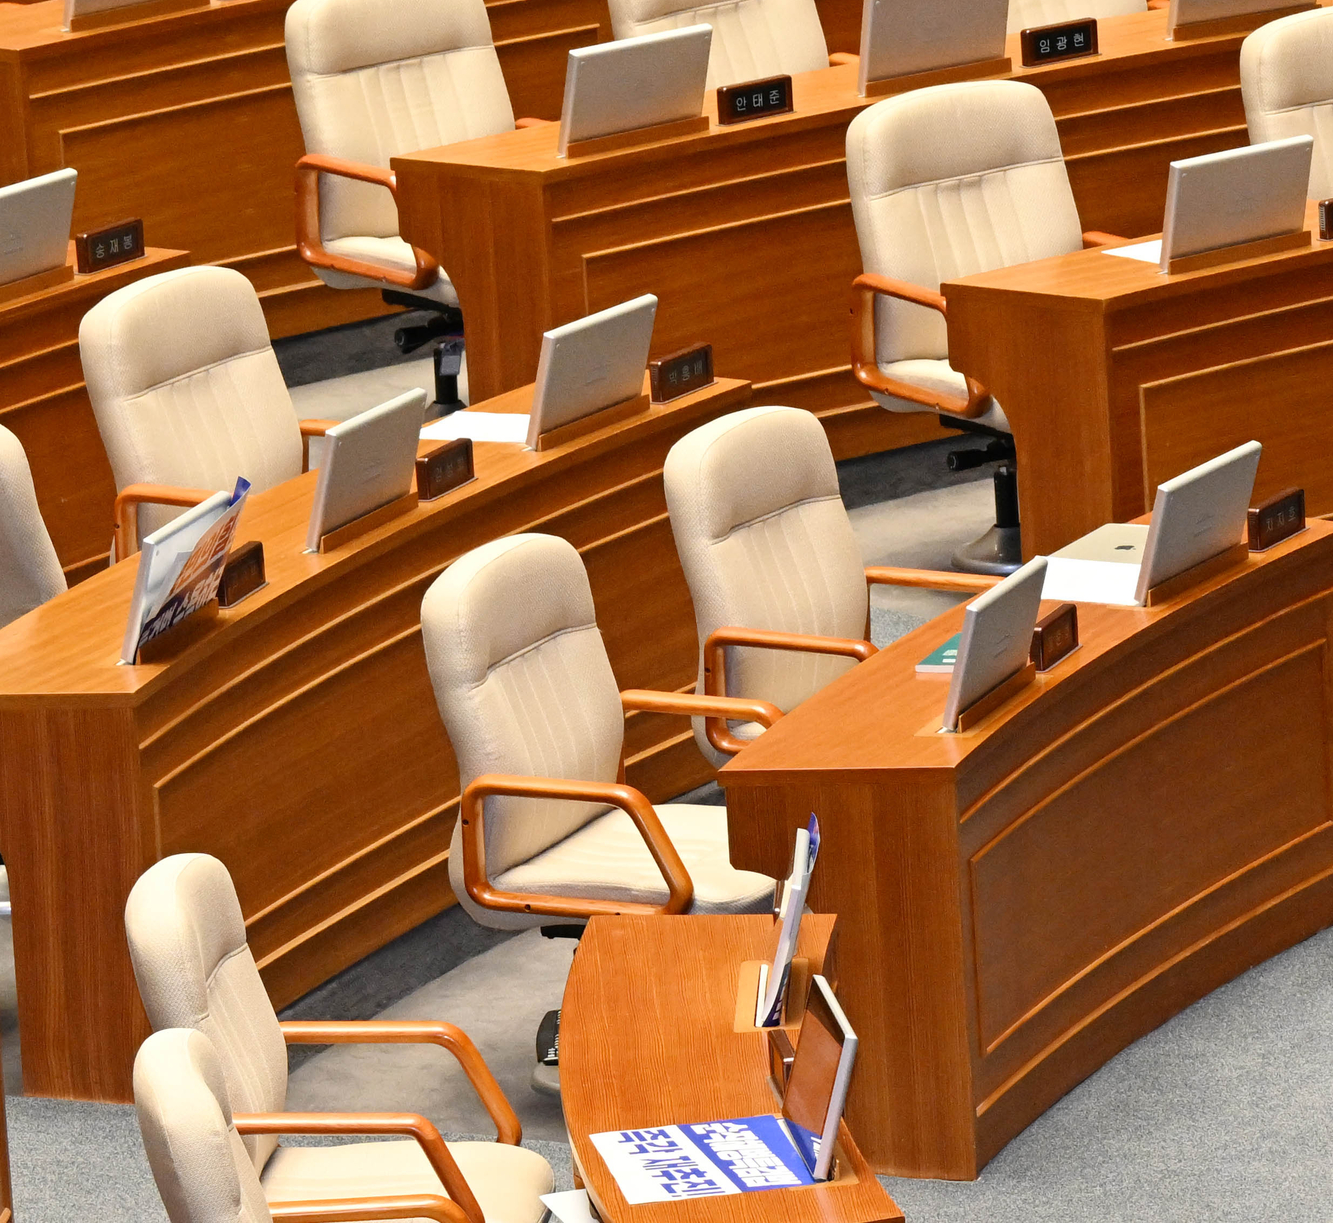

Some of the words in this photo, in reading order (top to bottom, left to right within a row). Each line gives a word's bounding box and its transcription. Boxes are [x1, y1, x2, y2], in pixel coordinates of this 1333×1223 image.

[1039, 33, 1084, 53] 임광현
[736, 90, 780, 110] 안태준
[96, 234, 133, 258] 송재봉
[618, 1129, 683, 1154] 즉각
[640, 1155, 726, 1197] 재추진!
